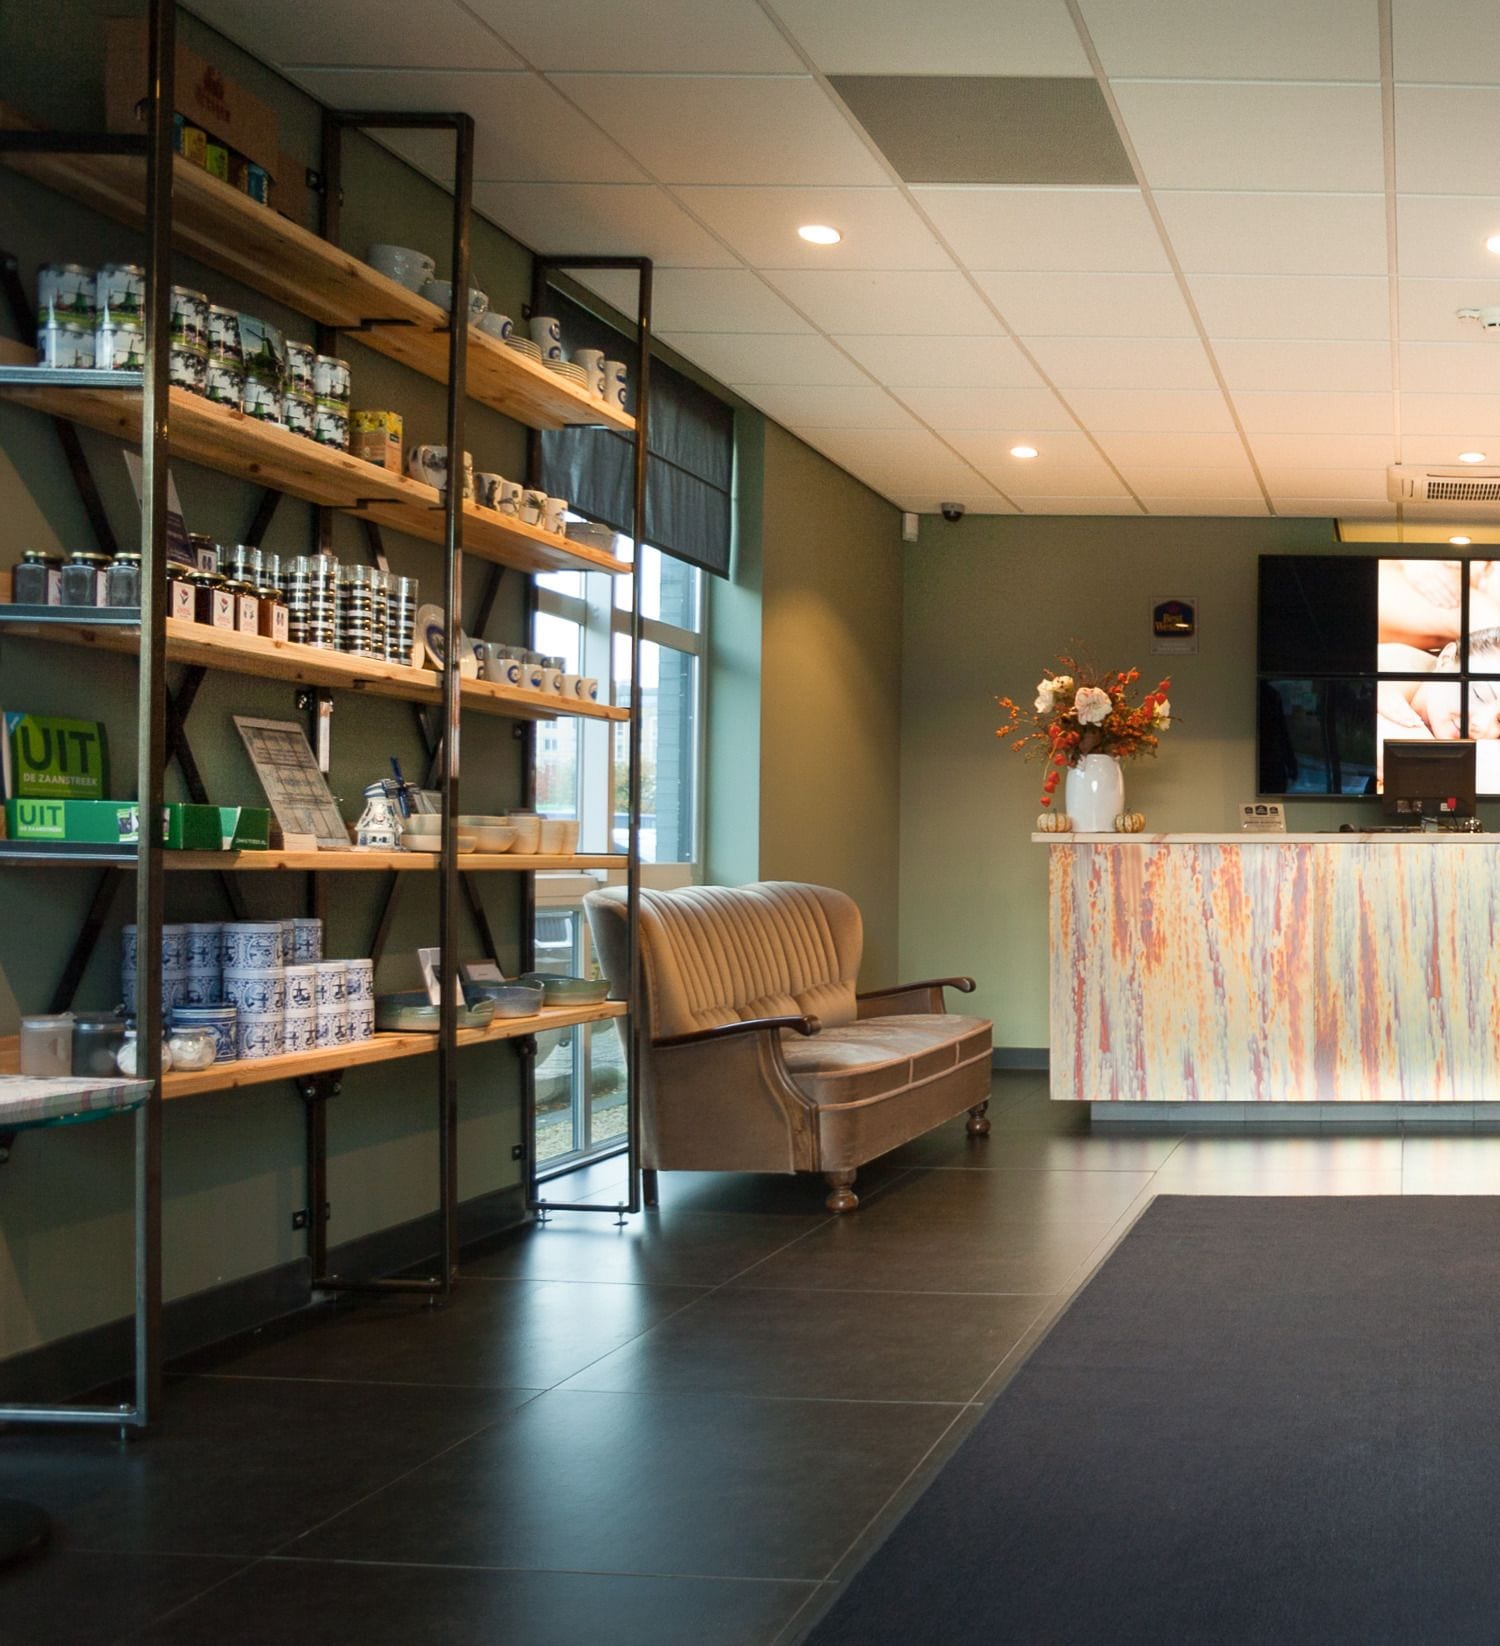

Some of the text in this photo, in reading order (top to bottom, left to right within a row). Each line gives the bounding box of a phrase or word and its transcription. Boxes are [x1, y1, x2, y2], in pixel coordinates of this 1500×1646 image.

[20, 726, 96, 773] UIT
[23, 773, 98, 786] DE ZAANSTREEK
[20, 805, 62, 826] UIT
